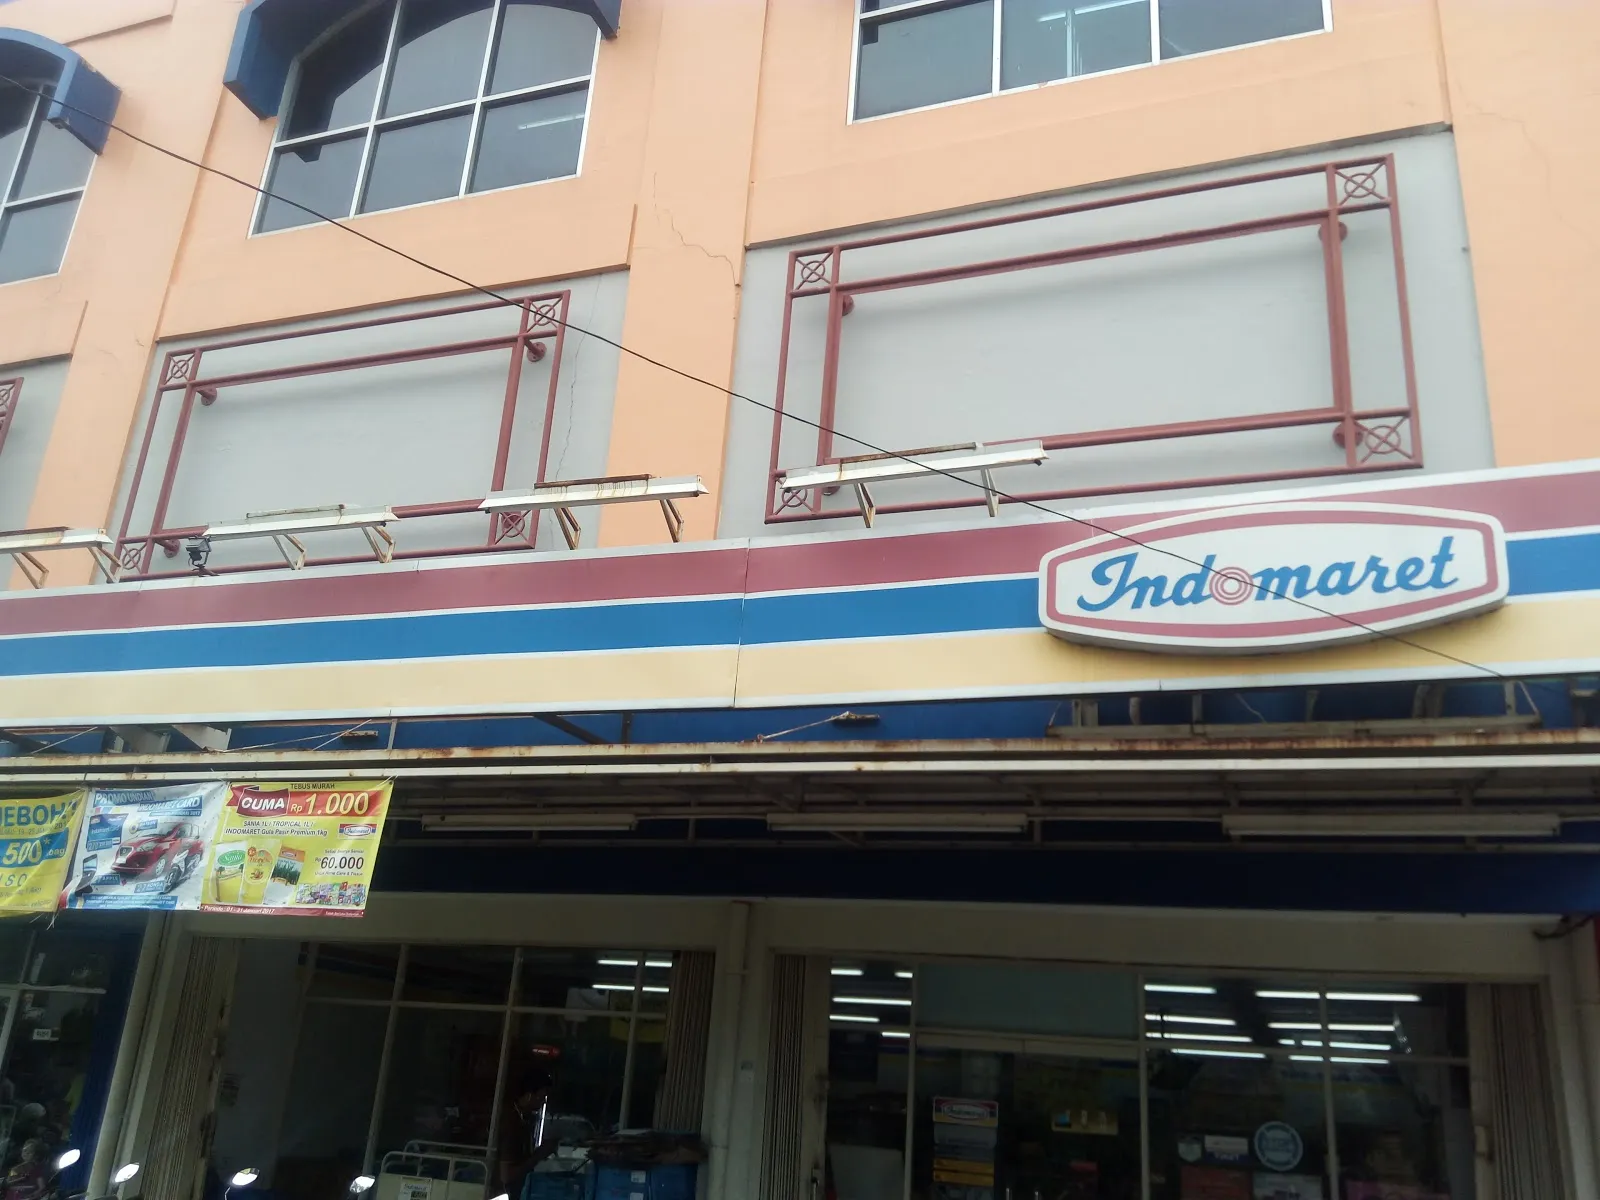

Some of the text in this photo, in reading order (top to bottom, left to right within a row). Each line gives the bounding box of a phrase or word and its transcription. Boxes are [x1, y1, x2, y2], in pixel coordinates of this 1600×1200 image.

[1077, 535, 1459, 613] Indomaret
[177, 797, 200, 808] CARD
[241, 796, 285, 810] CUMA
[290, 792, 369, 815] Rp 1.000
[290, 828, 316, 836] Premium
[316, 829, 328, 837] 1kg
[320, 856, 364, 870] 60.000
